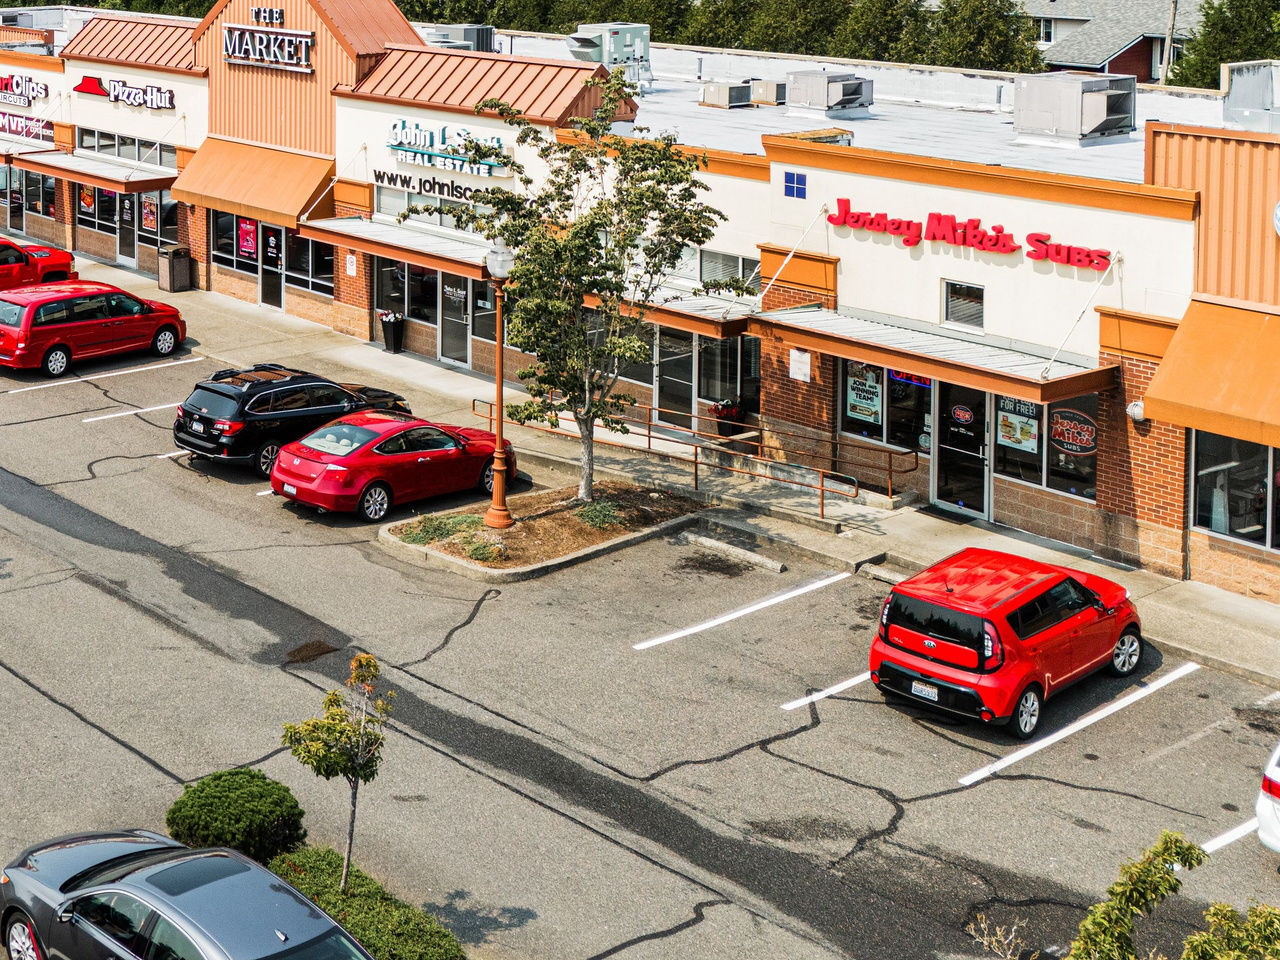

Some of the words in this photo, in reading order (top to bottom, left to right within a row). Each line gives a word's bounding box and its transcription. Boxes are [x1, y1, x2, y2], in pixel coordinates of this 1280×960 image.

[250, 7, 284, 24] THE
[222, 29, 315, 65] MARKET
[109, 80, 144, 107] Pizza
[144, 85, 175, 109] Hut
[387, 118, 434, 147] John
[398, 151, 433, 168] REAL
[436, 157, 493, 177] ESTATE
[827, 198, 922, 247] Jersey
[924, 212, 1022, 254] Mike's
[850, 385, 879, 398] WINNING
[852, 379, 867, 388] JOIN
[855, 392, 874, 403] TEAM!
[1000, 400, 1014, 411] FOR
[1016, 403, 1036, 416] FREE!
[1050, 414, 1096, 438] Jersey
[1063, 443, 1081, 452] SUBS
